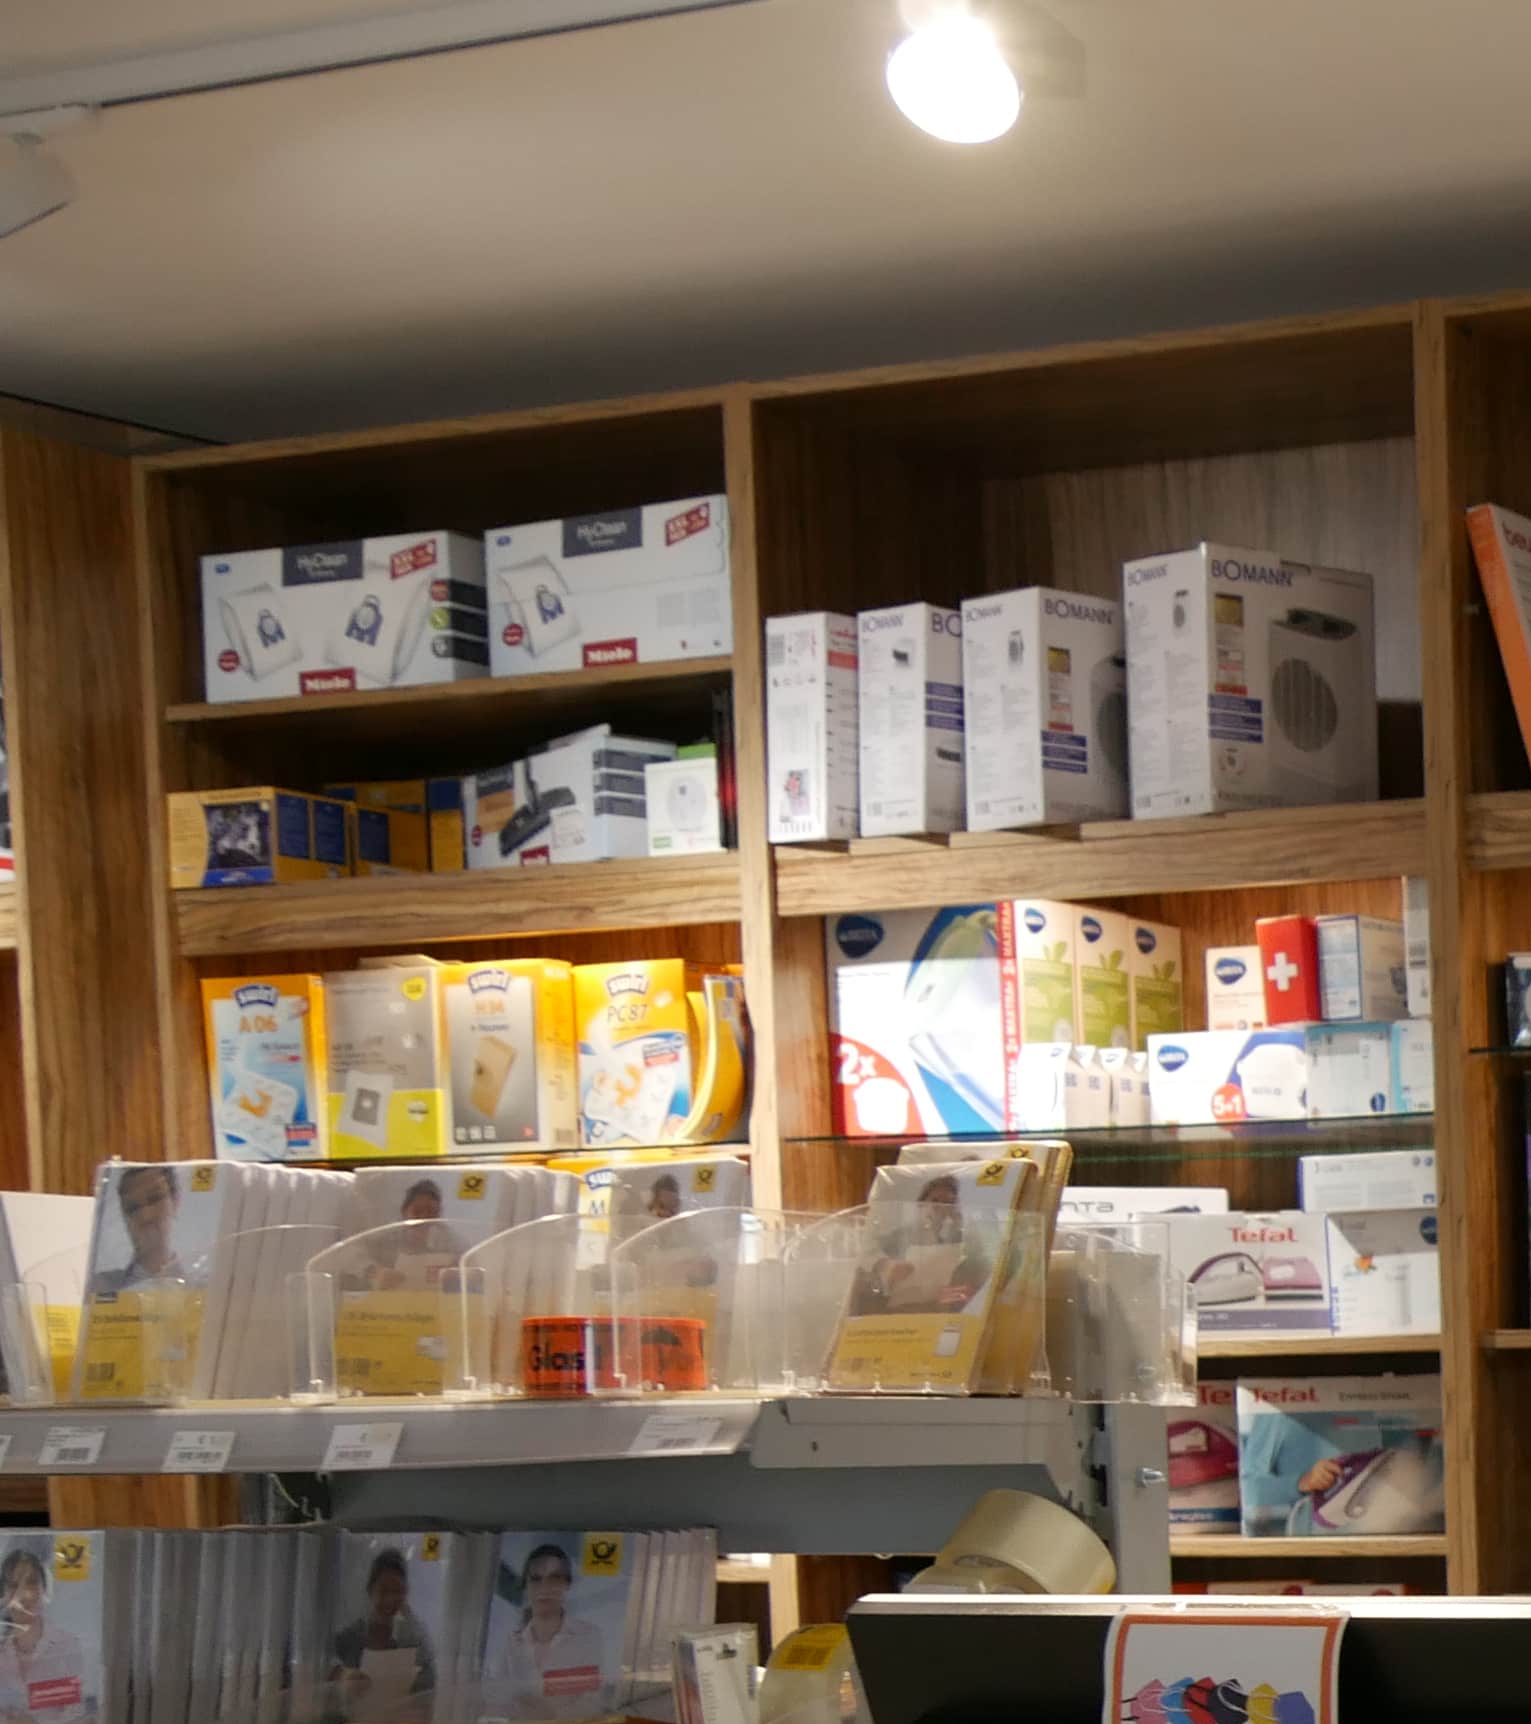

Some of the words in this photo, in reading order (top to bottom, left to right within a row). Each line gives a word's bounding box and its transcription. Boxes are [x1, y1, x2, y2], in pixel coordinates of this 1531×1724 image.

[1211, 559, 1293, 588] BOMANN
[1045, 599, 1113, 625] BOMANN
[837, 1045, 876, 1084] 2x
[1230, 1227, 1298, 1242] Tefal
[1252, 1386, 1319, 1402] Tefal
